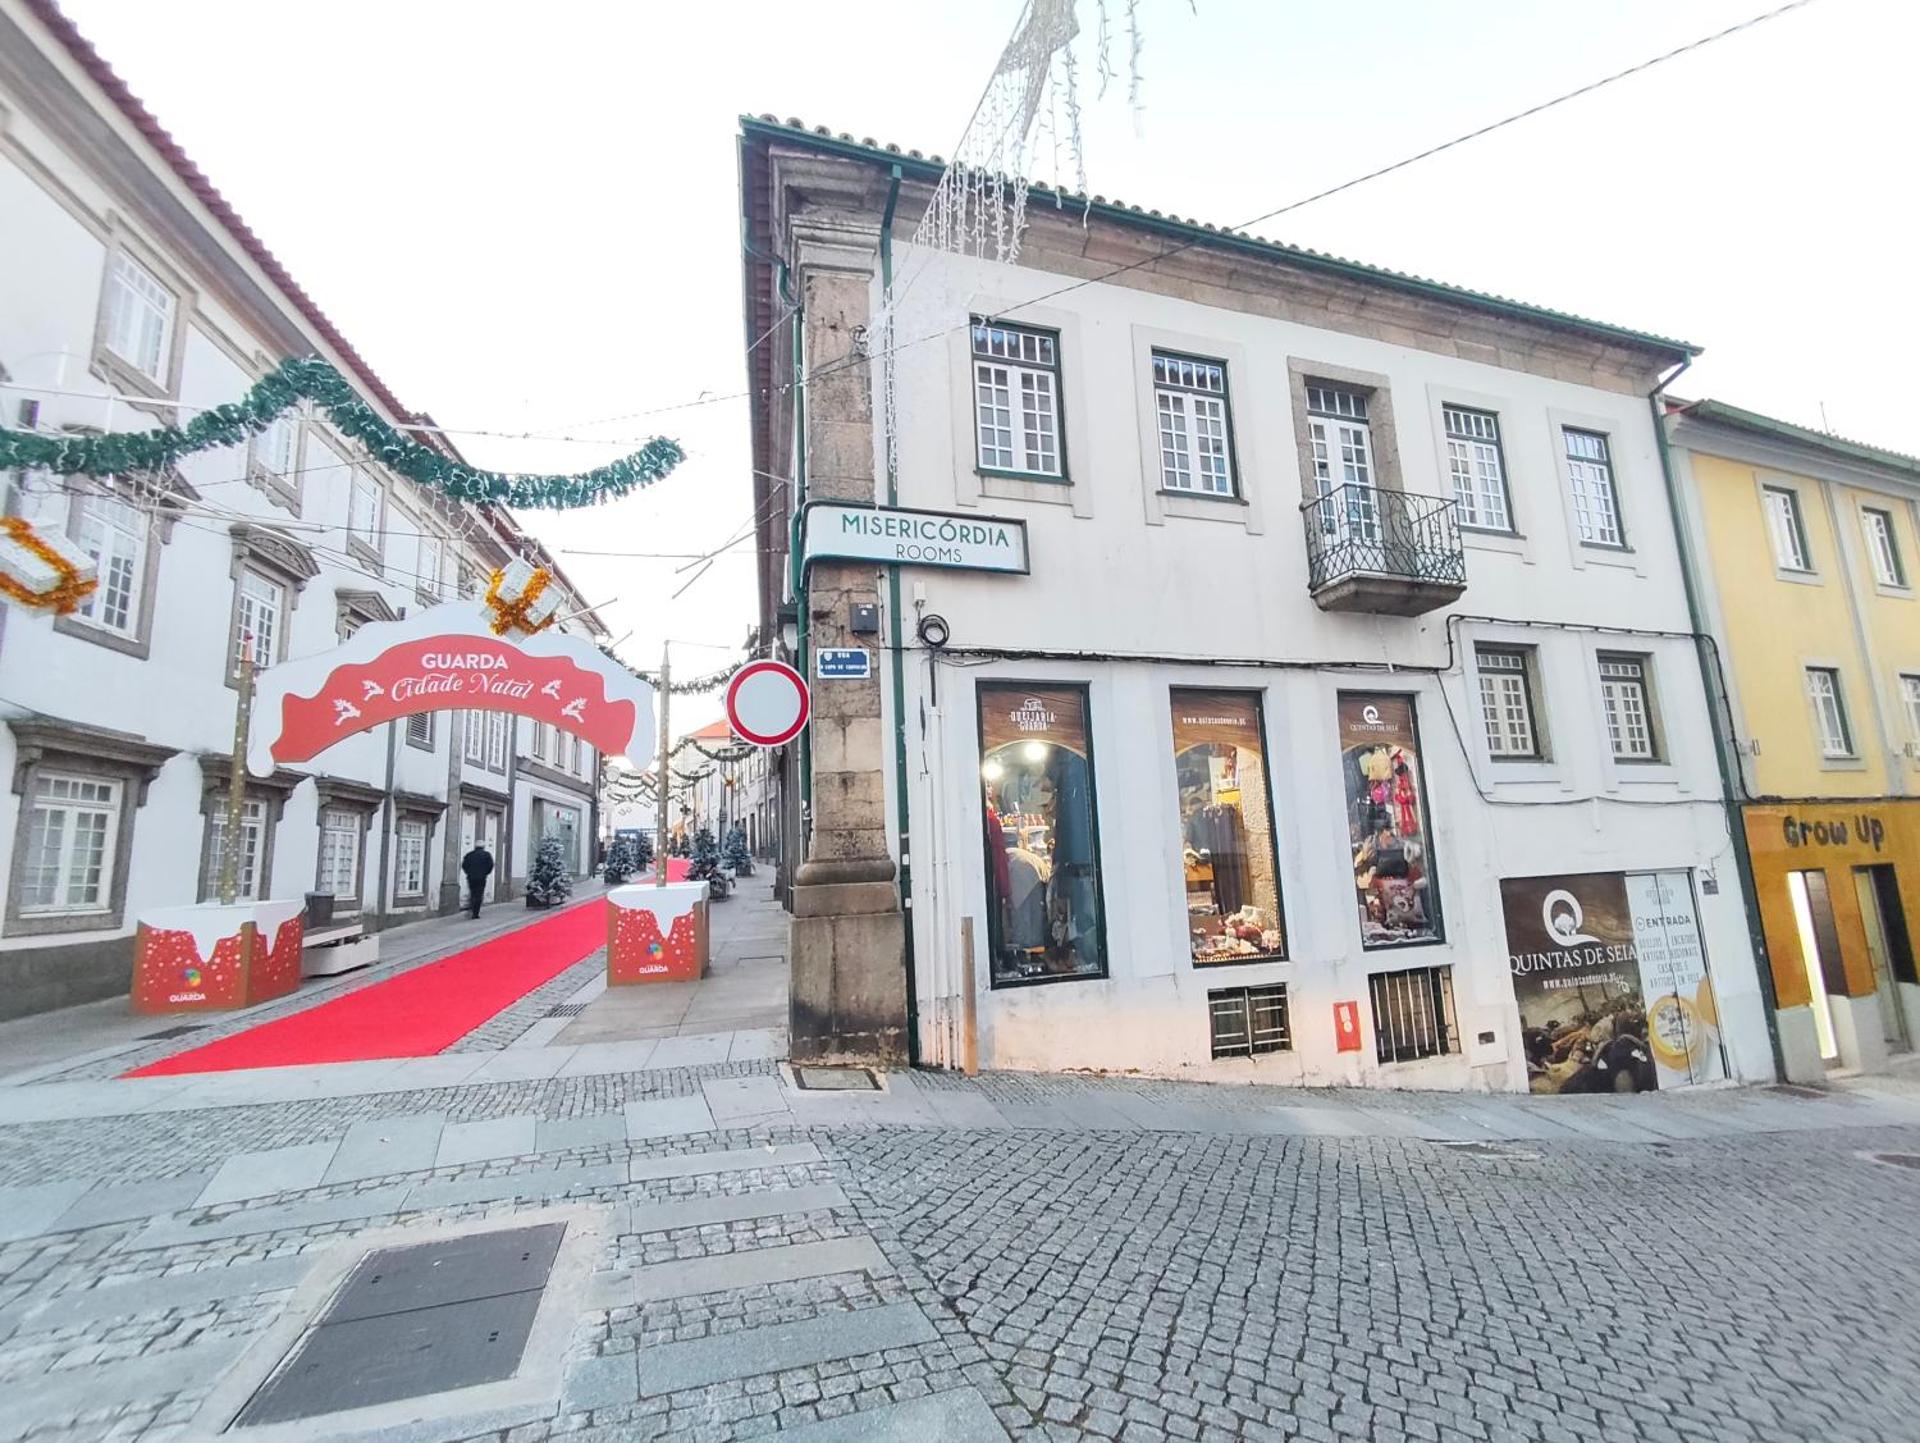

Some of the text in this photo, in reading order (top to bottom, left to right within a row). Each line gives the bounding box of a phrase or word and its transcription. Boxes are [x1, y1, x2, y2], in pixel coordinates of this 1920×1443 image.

[842, 513, 1009, 548] MISERICÓRDIA
[896, 543, 962, 563] ROOMS
[421, 653, 509, 670] GUARDA
[391, 672, 534, 702] Cidade Natal
[1783, 814, 1884, 853] Grow Up
[1645, 915, 1692, 929] ENTRADA
[639, 965, 669, 974] GUARDA
[1509, 943, 1637, 976] QUINTAS DE SEIA
[169, 993, 206, 1003] GUARDA
